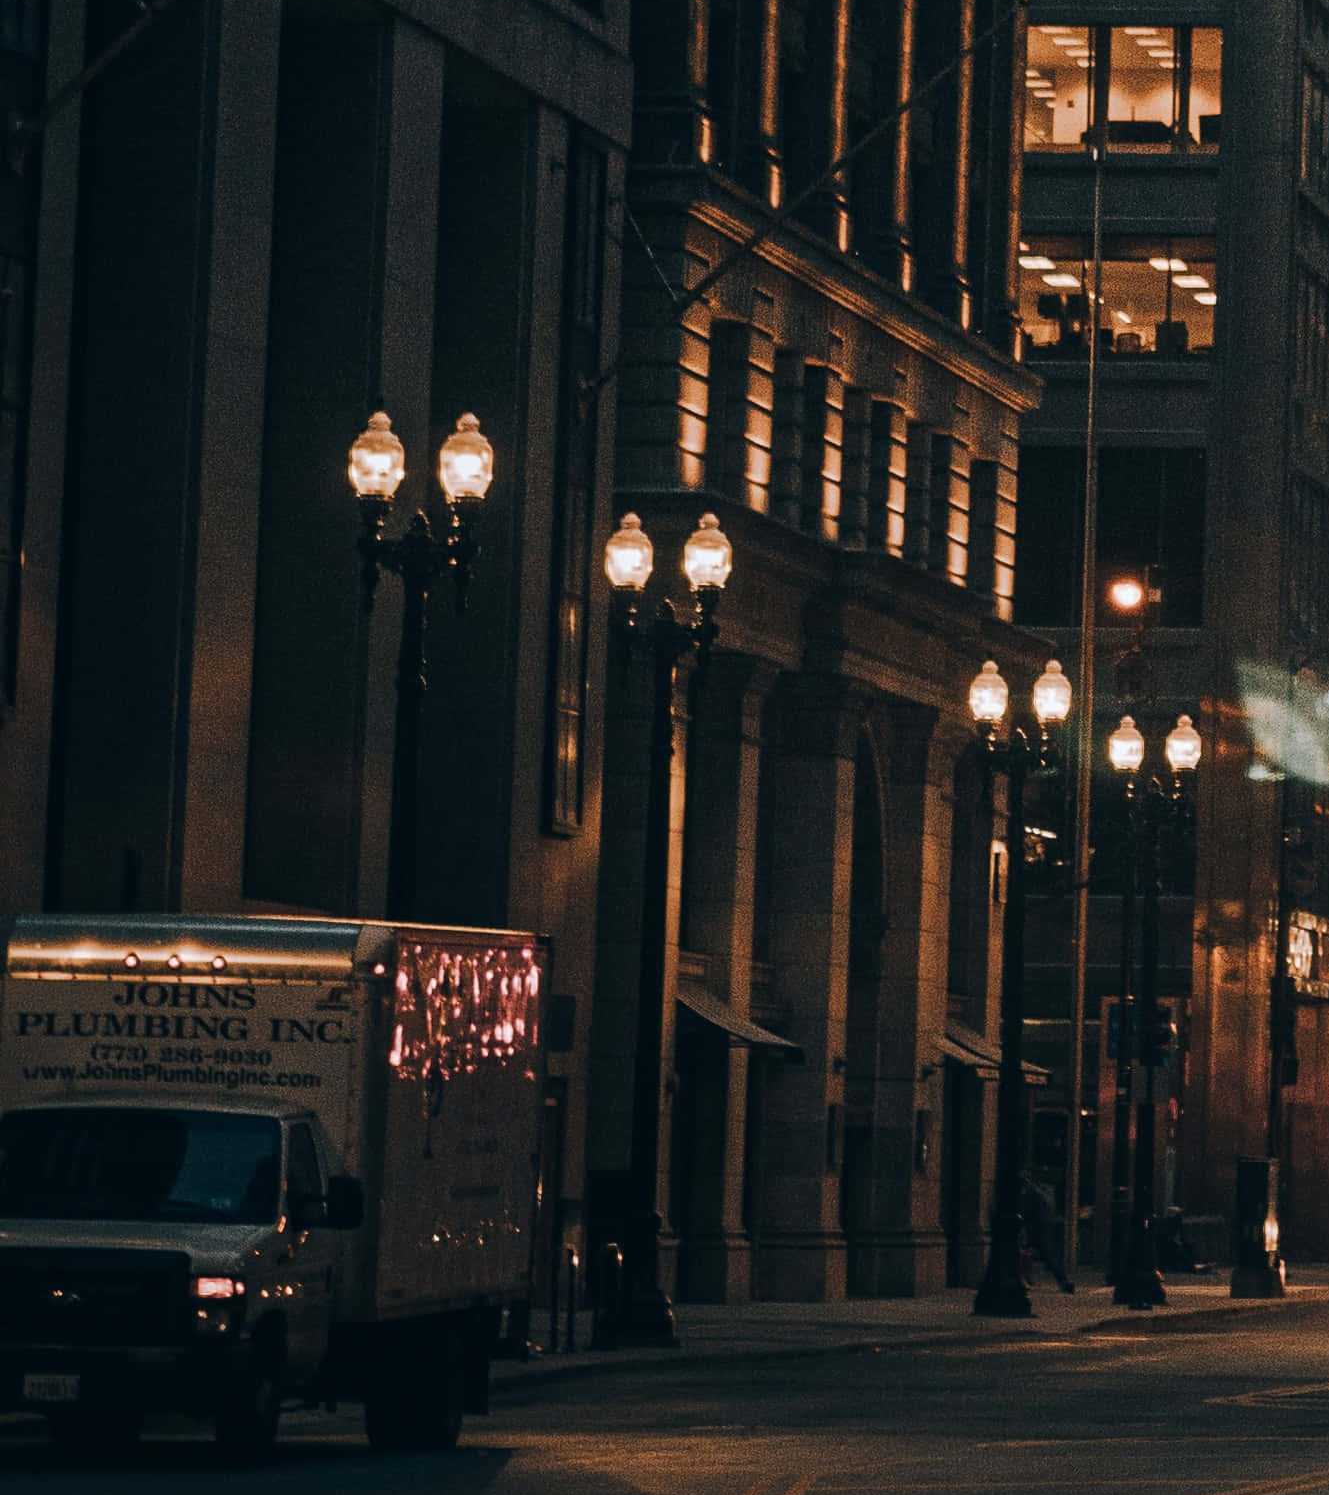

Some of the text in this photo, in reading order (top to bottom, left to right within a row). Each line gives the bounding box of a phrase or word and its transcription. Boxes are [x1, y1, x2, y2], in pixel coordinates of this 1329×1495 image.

[115, 984, 256, 1008] JOHNS
[18, 1013, 357, 1044] PLUMBING INC.
[91, 1044, 148, 1062] (773)
